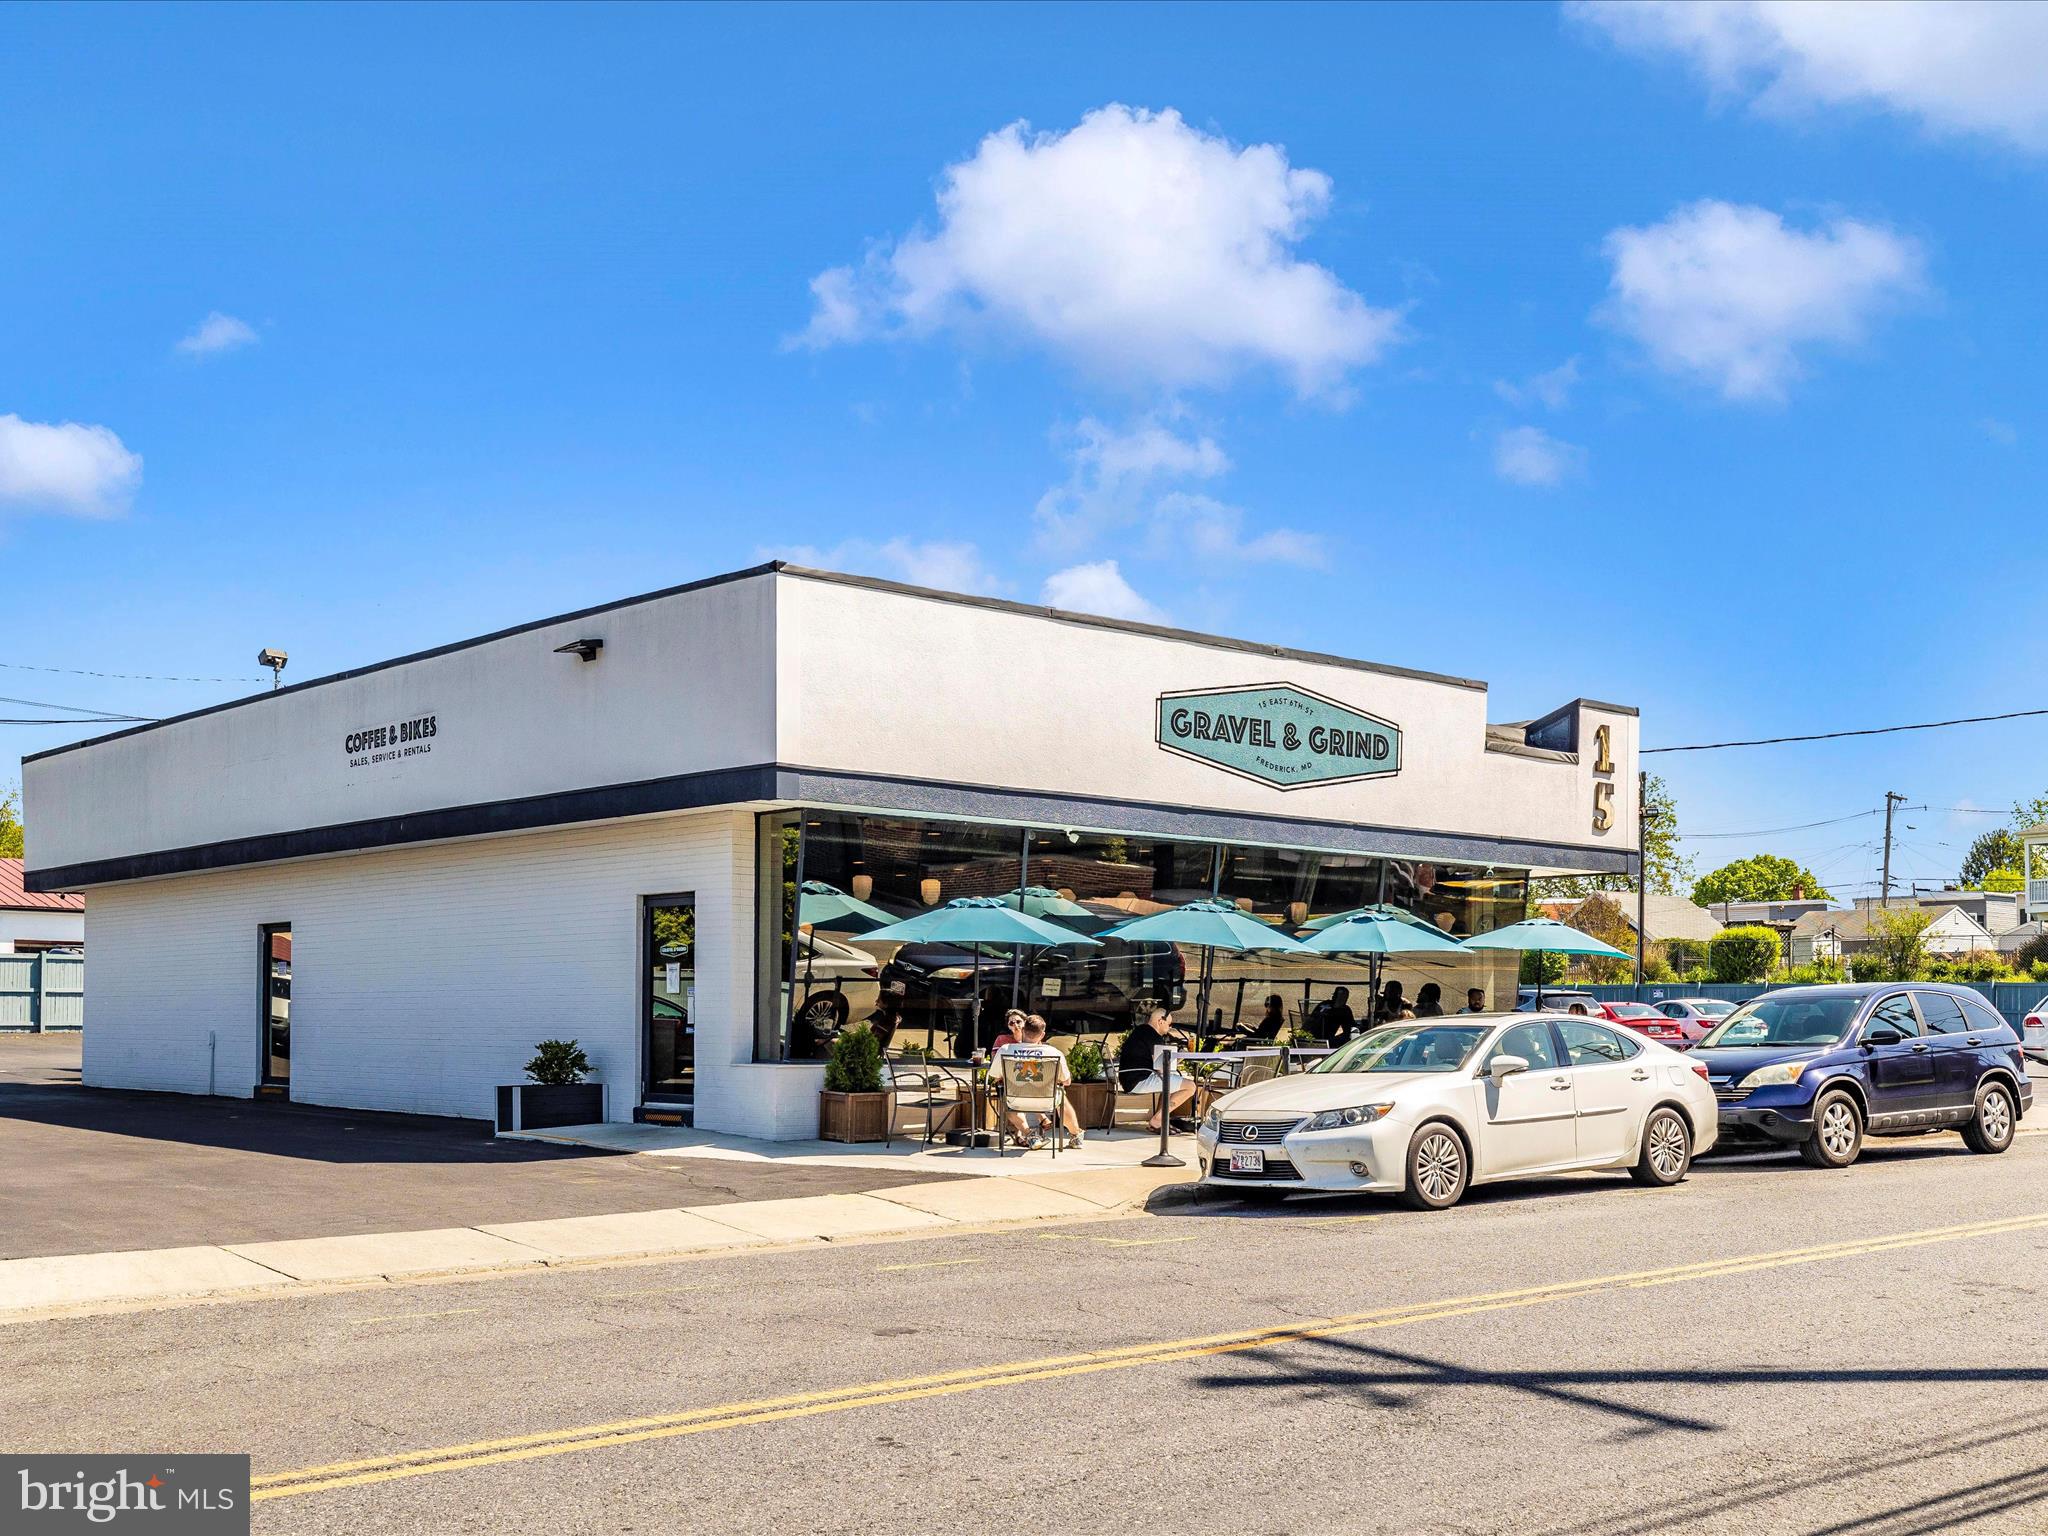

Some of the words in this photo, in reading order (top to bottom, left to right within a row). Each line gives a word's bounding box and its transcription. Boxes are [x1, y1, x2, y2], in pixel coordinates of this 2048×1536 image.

[1258, 701, 1267, 709] 15
[1305, 707, 1314, 716] ST
[345, 727, 387, 754] COFFEE
[389, 725, 398, 745] &
[400, 716, 437, 742] BIKES
[1170, 708, 1276, 748] GRAVEL
[1282, 722, 1302, 751] &
[1308, 726, 1390, 761] GRIND
[349, 757, 370, 768] SALES,
[371, 750, 396, 763] SERVICE
[397, 750, 402, 758] &
[404, 744, 431, 757] RENTALS
[1301, 762, 1313, 771] MD
